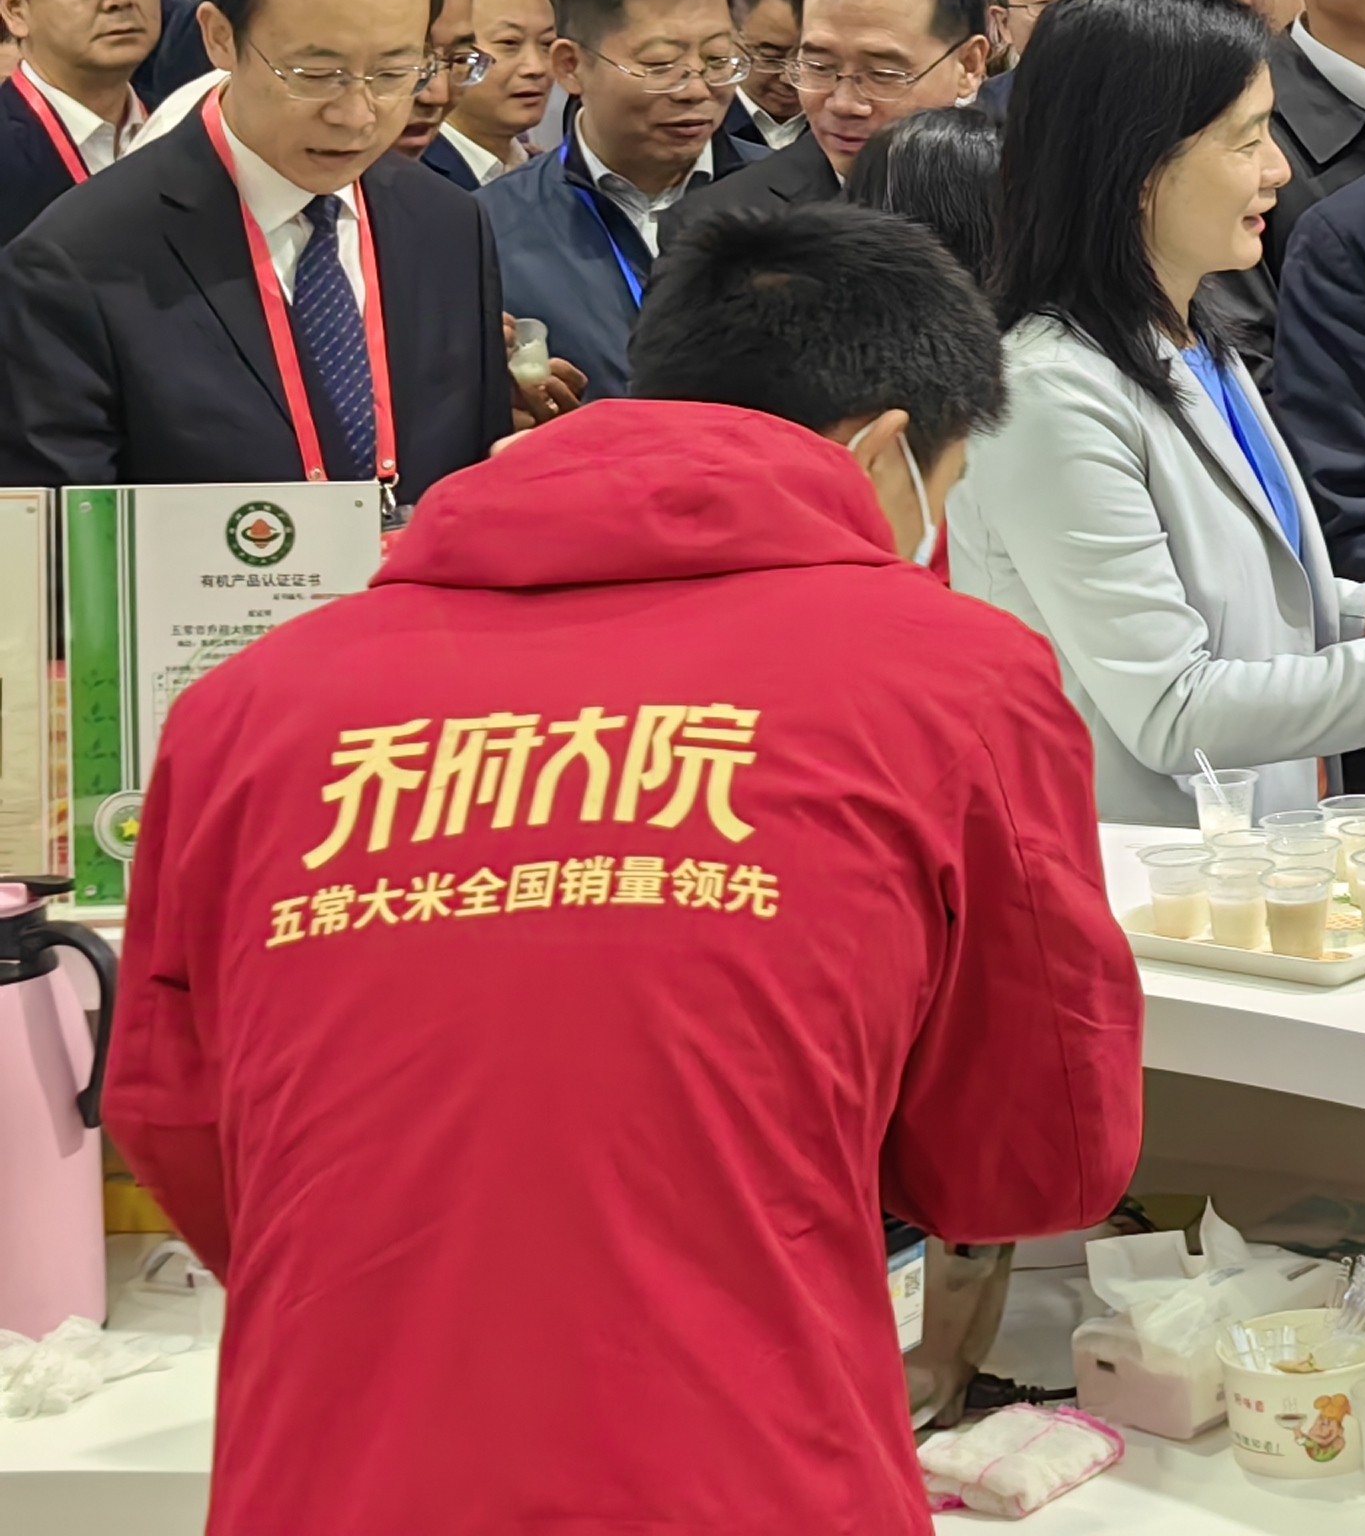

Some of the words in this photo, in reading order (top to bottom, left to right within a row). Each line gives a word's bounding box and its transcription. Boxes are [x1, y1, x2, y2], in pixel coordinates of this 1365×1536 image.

[201, 574, 321, 588] 有机产品认证证书
[302, 703, 761, 870] 乔府大院
[265, 855, 780, 948] 五常大米全国销量领先
